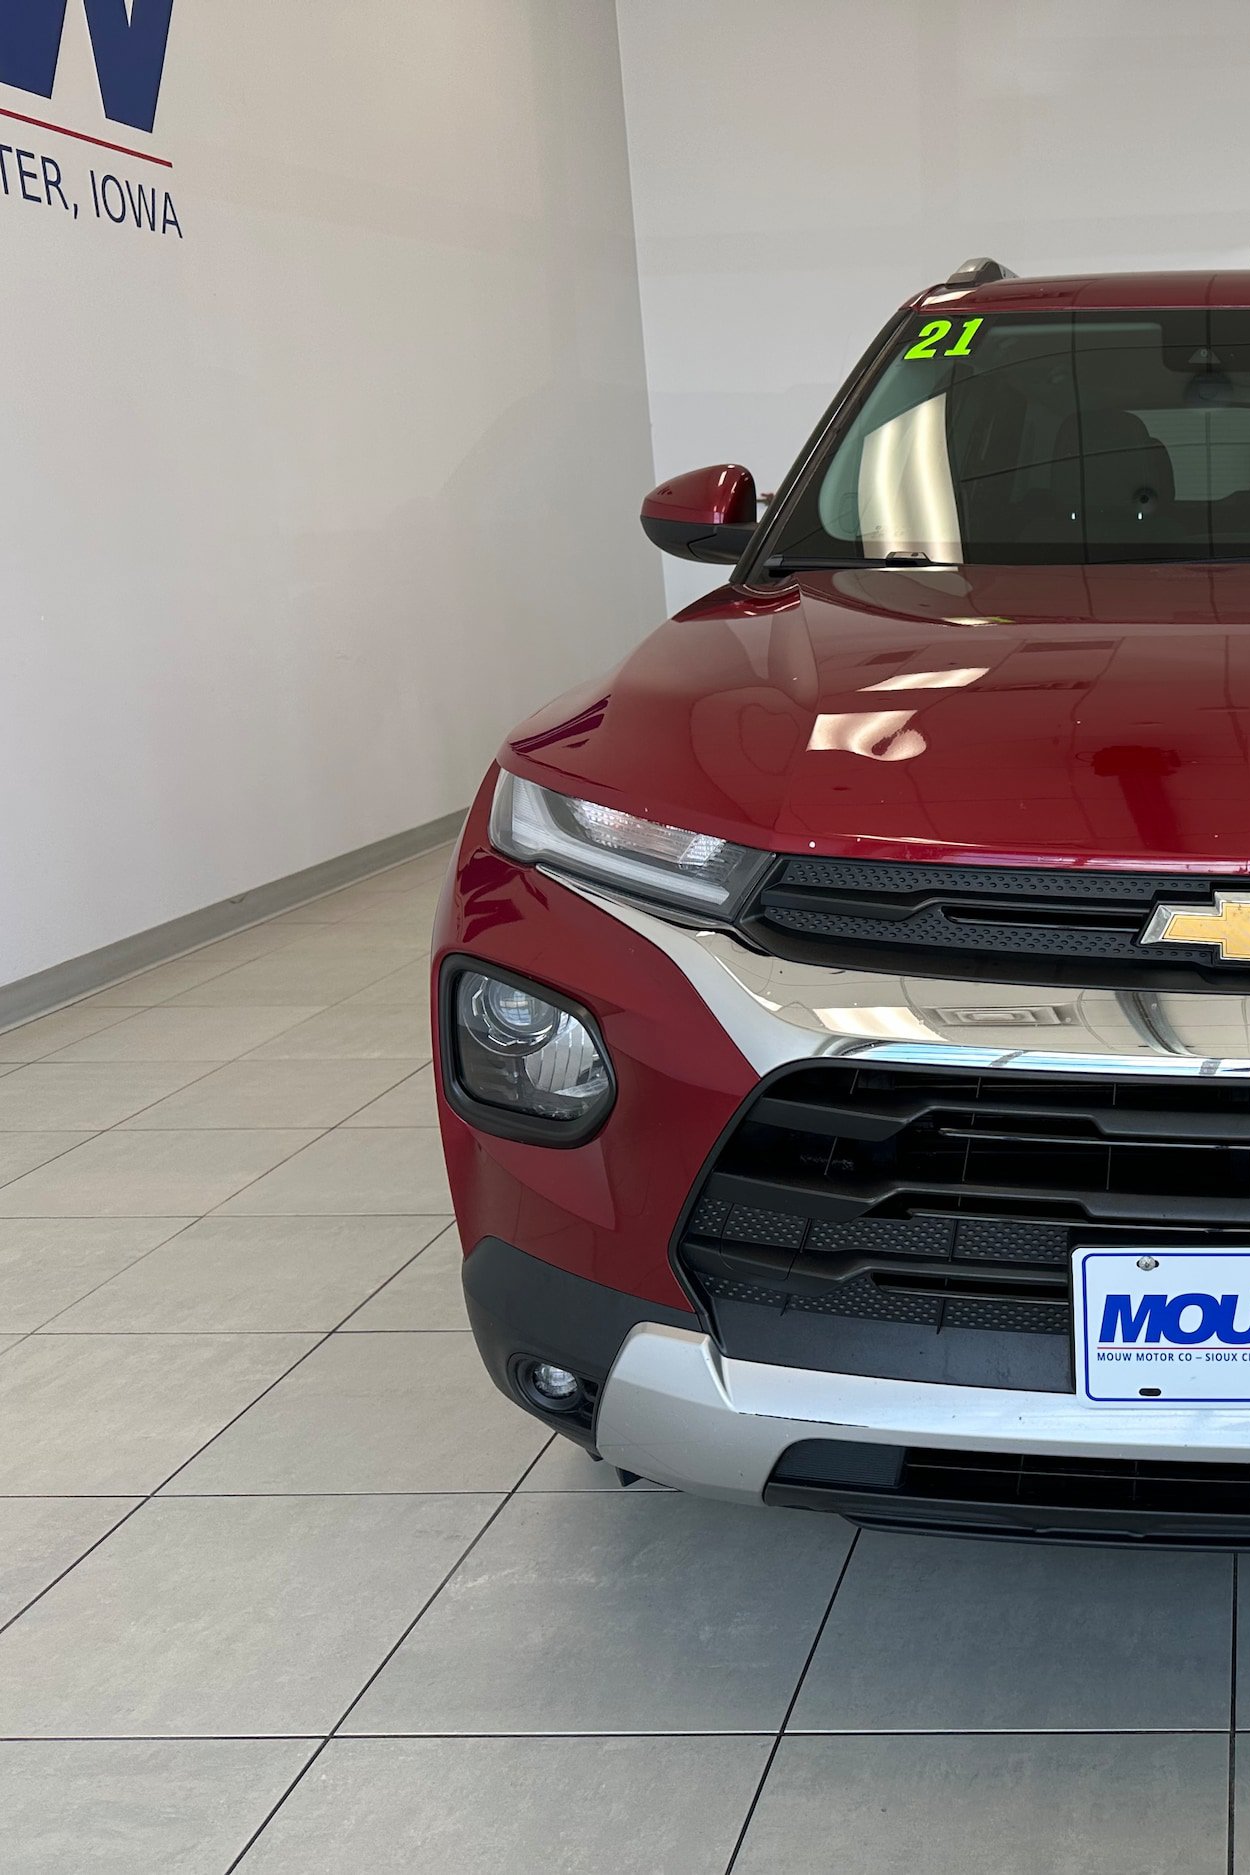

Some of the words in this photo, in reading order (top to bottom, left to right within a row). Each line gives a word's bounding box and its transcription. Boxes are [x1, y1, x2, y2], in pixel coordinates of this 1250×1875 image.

[90, 170, 183, 239] IOWA
[903, 317, 984, 360] 21
[1096, 1352, 1132, 1362] MOUW
[1136, 1352, 1174, 1362] MOTOR
[1178, 1352, 1193, 1362] CO
[1205, 1352, 1238, 1362] SIOUX
